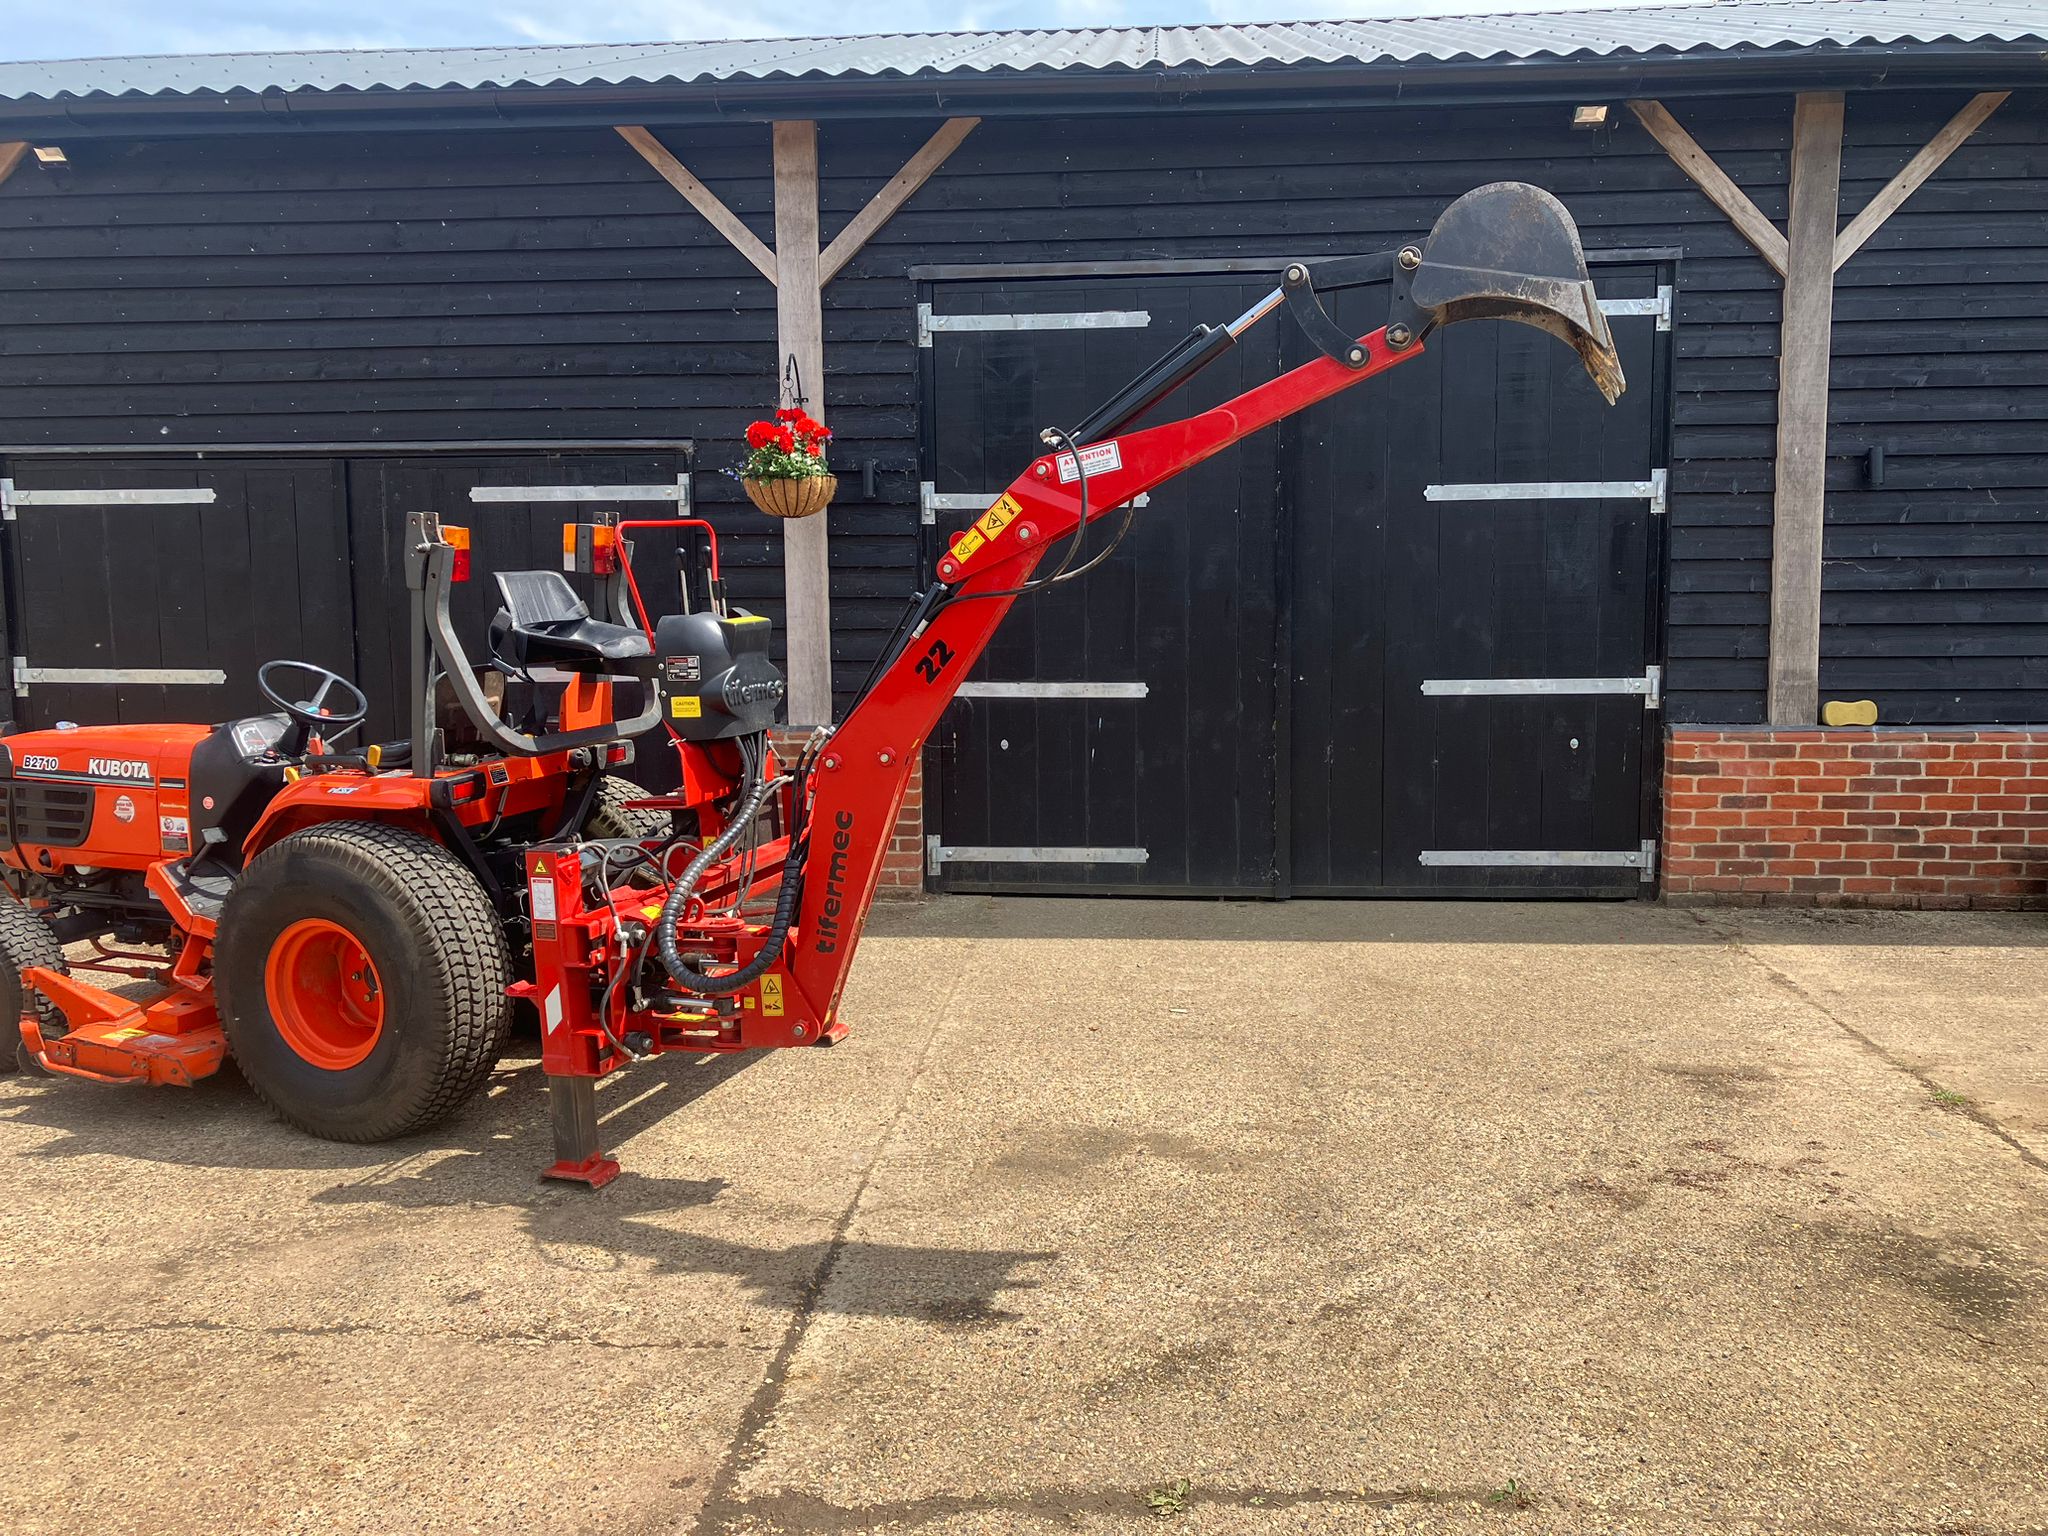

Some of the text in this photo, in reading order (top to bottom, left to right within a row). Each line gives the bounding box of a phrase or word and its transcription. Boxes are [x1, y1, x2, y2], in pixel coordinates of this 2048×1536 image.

[1064, 448, 1112, 466] ATENTION
[914, 639, 956, 685] 22
[23, 755, 58, 770] B2710
[88, 758, 150, 778] KUBOTA
[816, 810, 853, 954] tifermec
